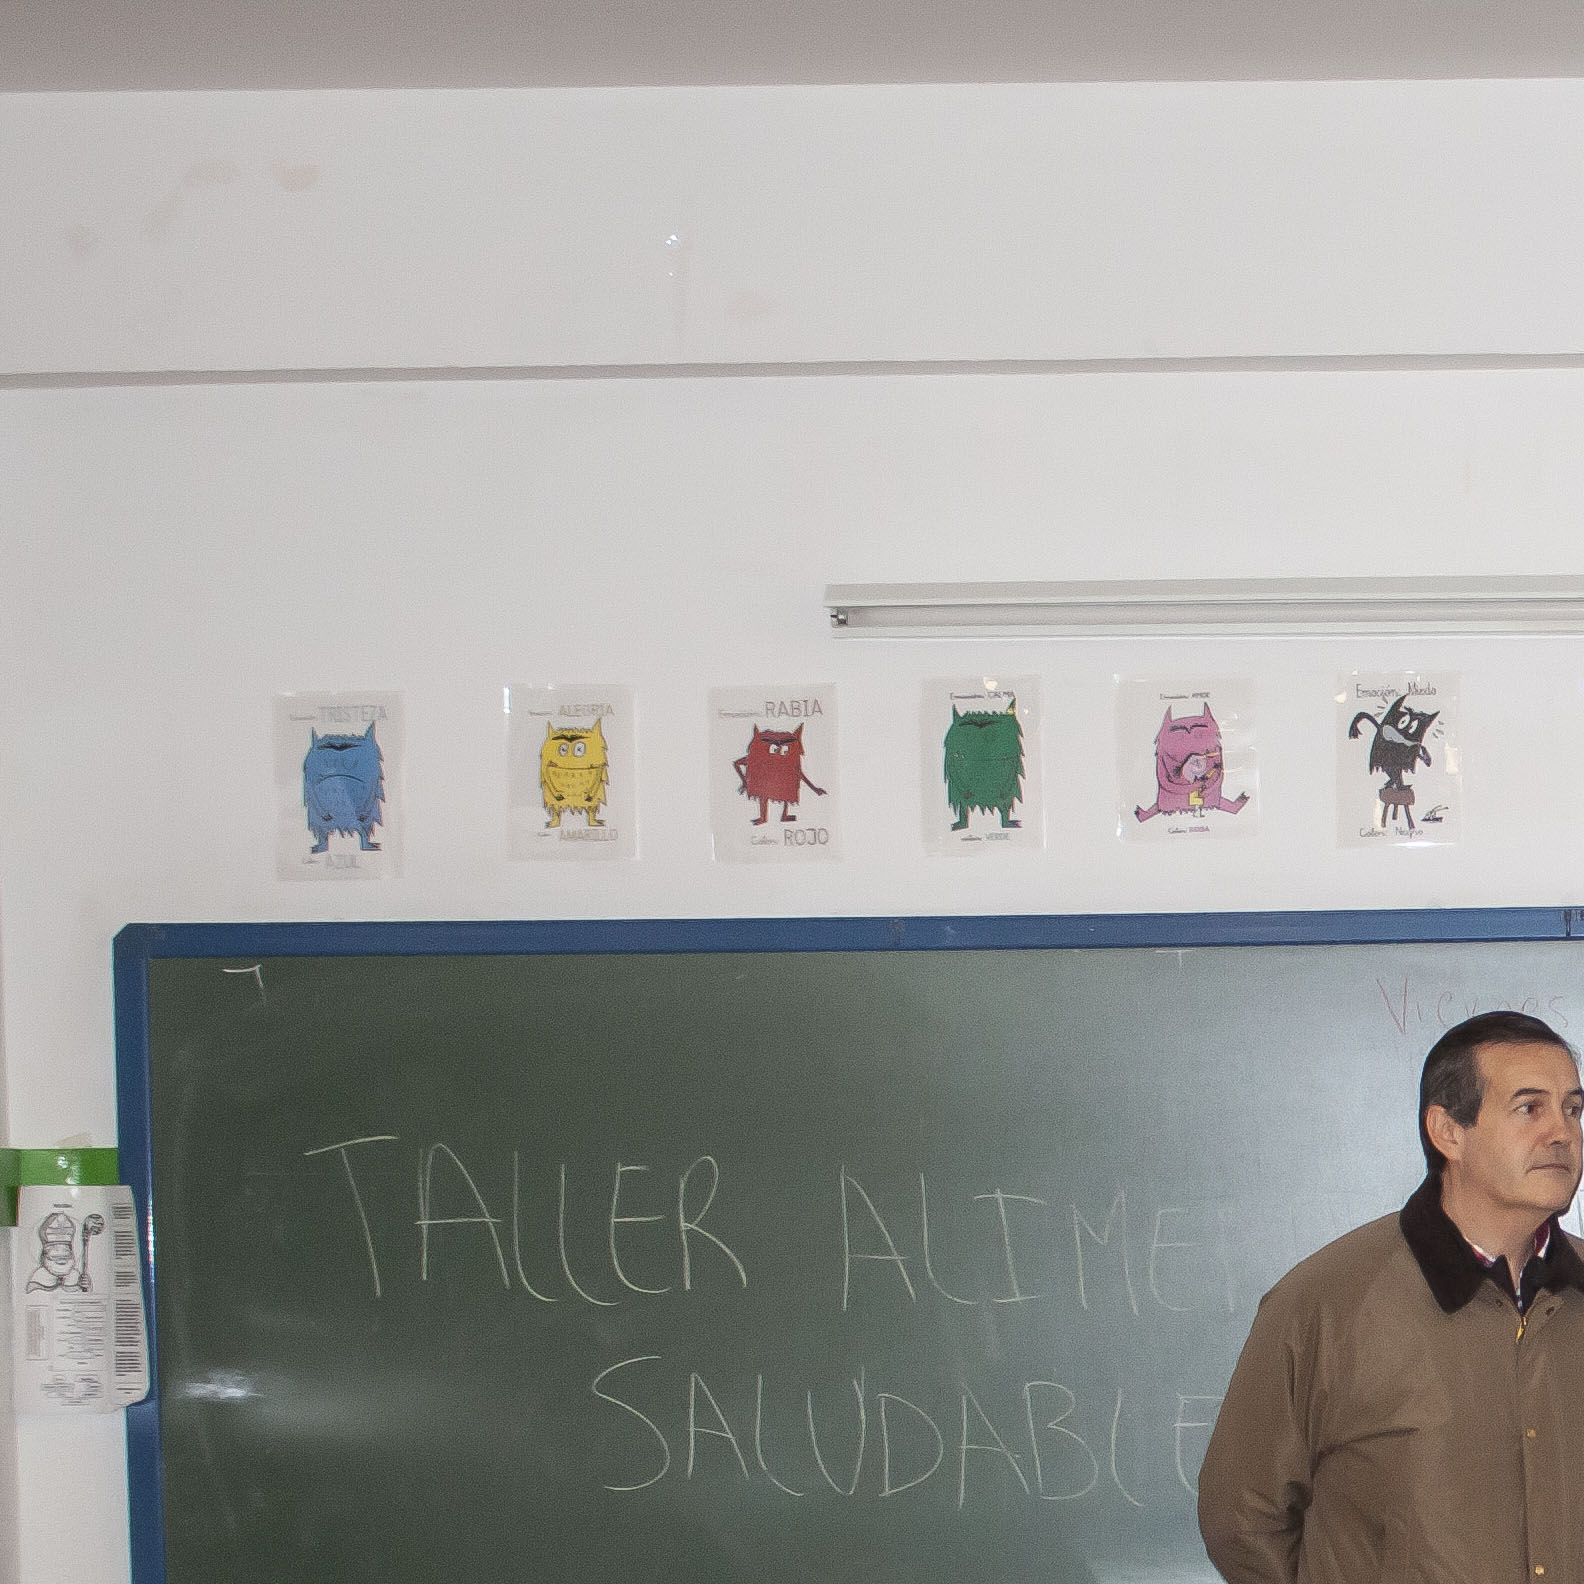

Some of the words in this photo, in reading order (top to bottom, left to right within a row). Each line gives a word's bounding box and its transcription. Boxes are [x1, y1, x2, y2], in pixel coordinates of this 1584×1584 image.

[765, 699, 824, 718] RABIA
[783, 827, 830, 846] ROJO
[303, 1134, 748, 1307] TALLER
[592, 1355, 1220, 1509] SALUDABLE
